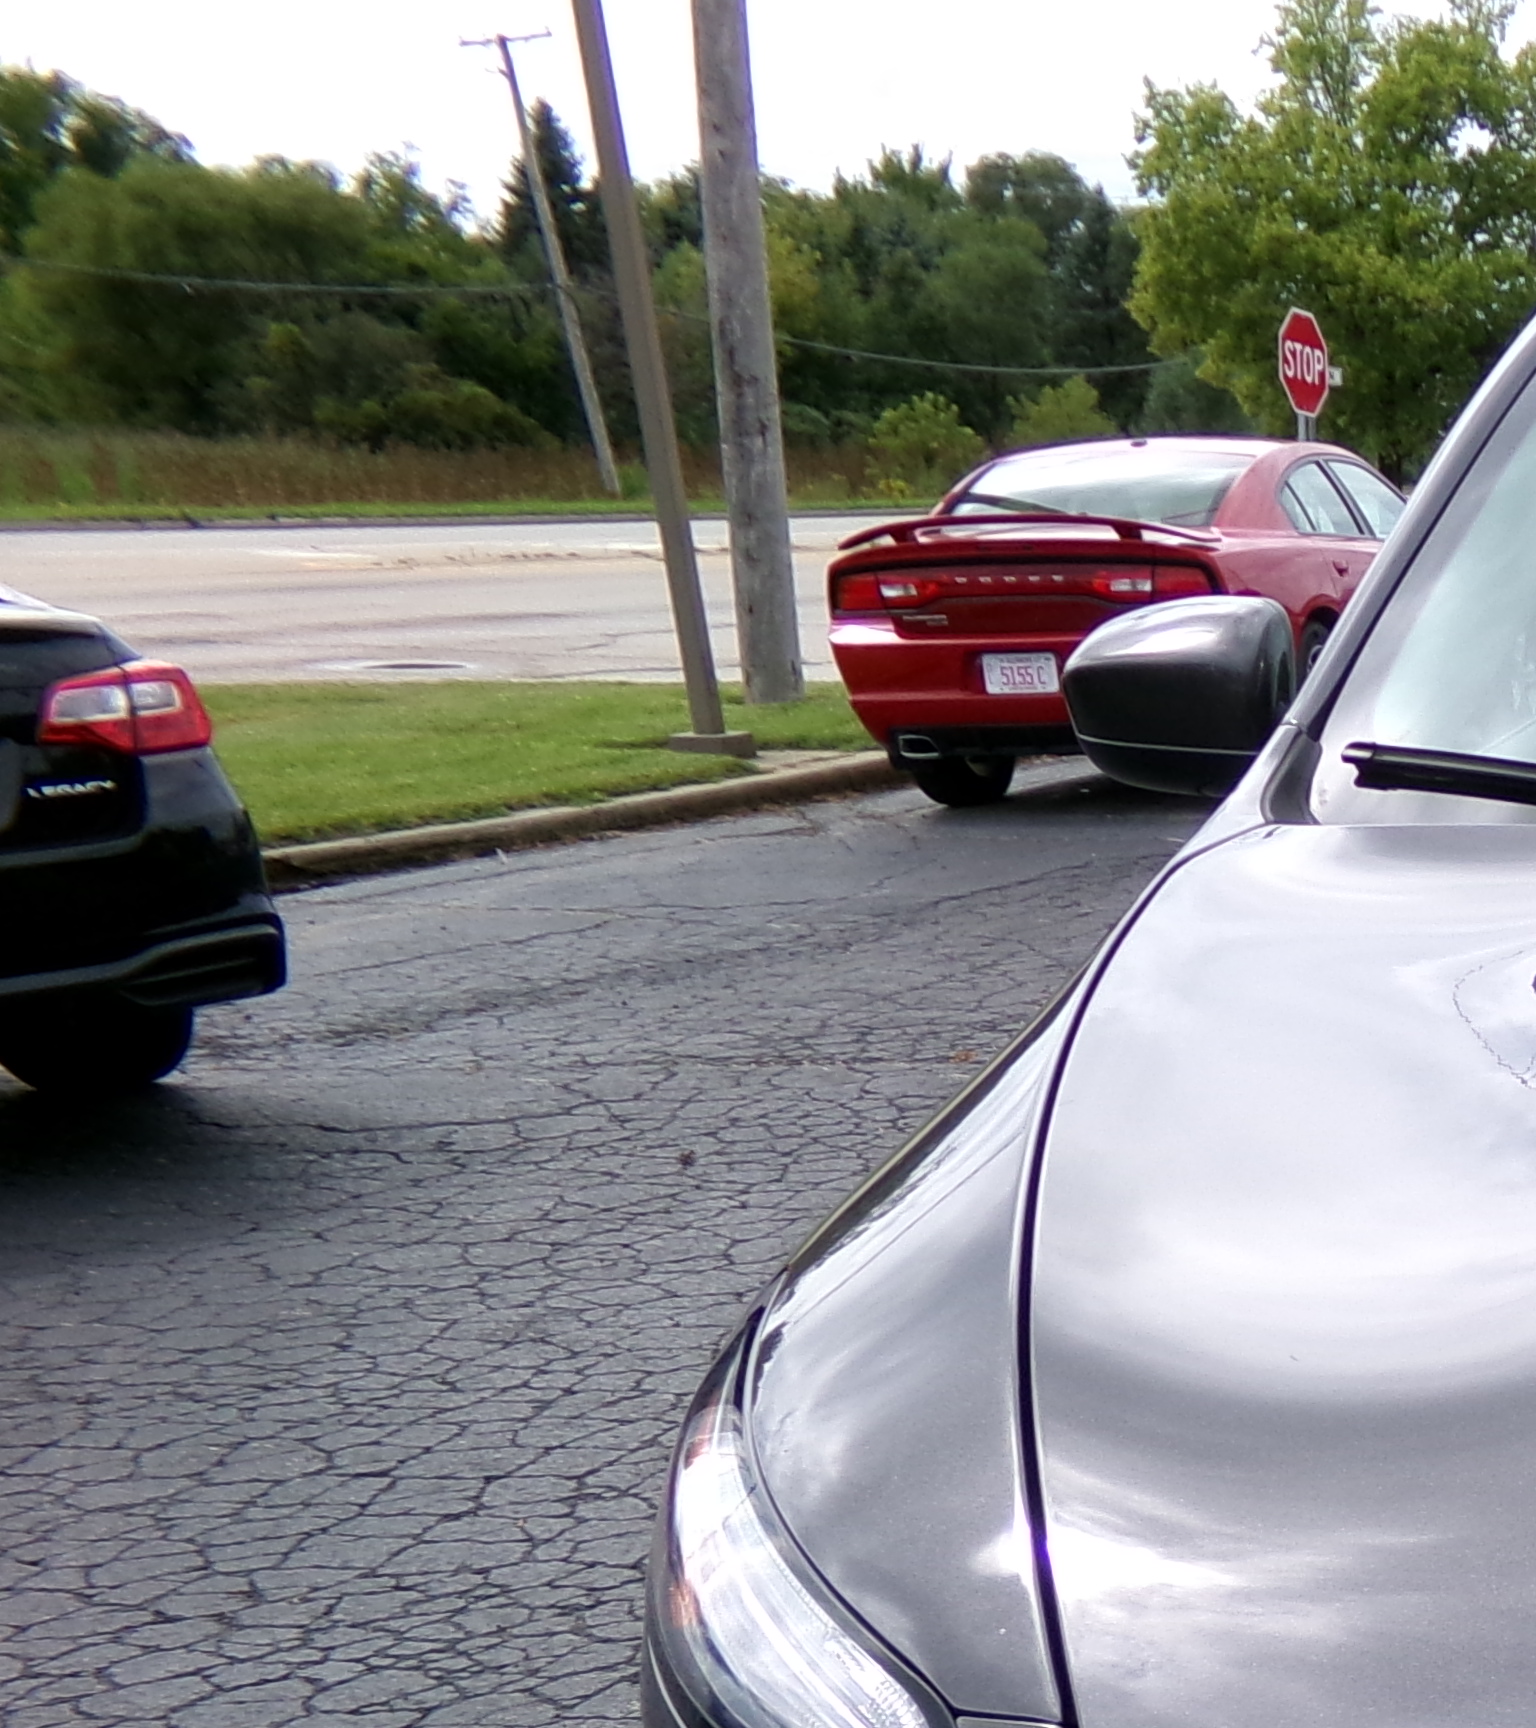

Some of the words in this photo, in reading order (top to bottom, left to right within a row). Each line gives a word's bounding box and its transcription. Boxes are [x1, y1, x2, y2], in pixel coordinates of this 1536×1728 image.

[1284, 340, 1324, 386] STOP
[1001, 666, 1034, 686] 5155
[1036, 665, 1047, 685] C
[25, 780, 118, 799] LEGACY
